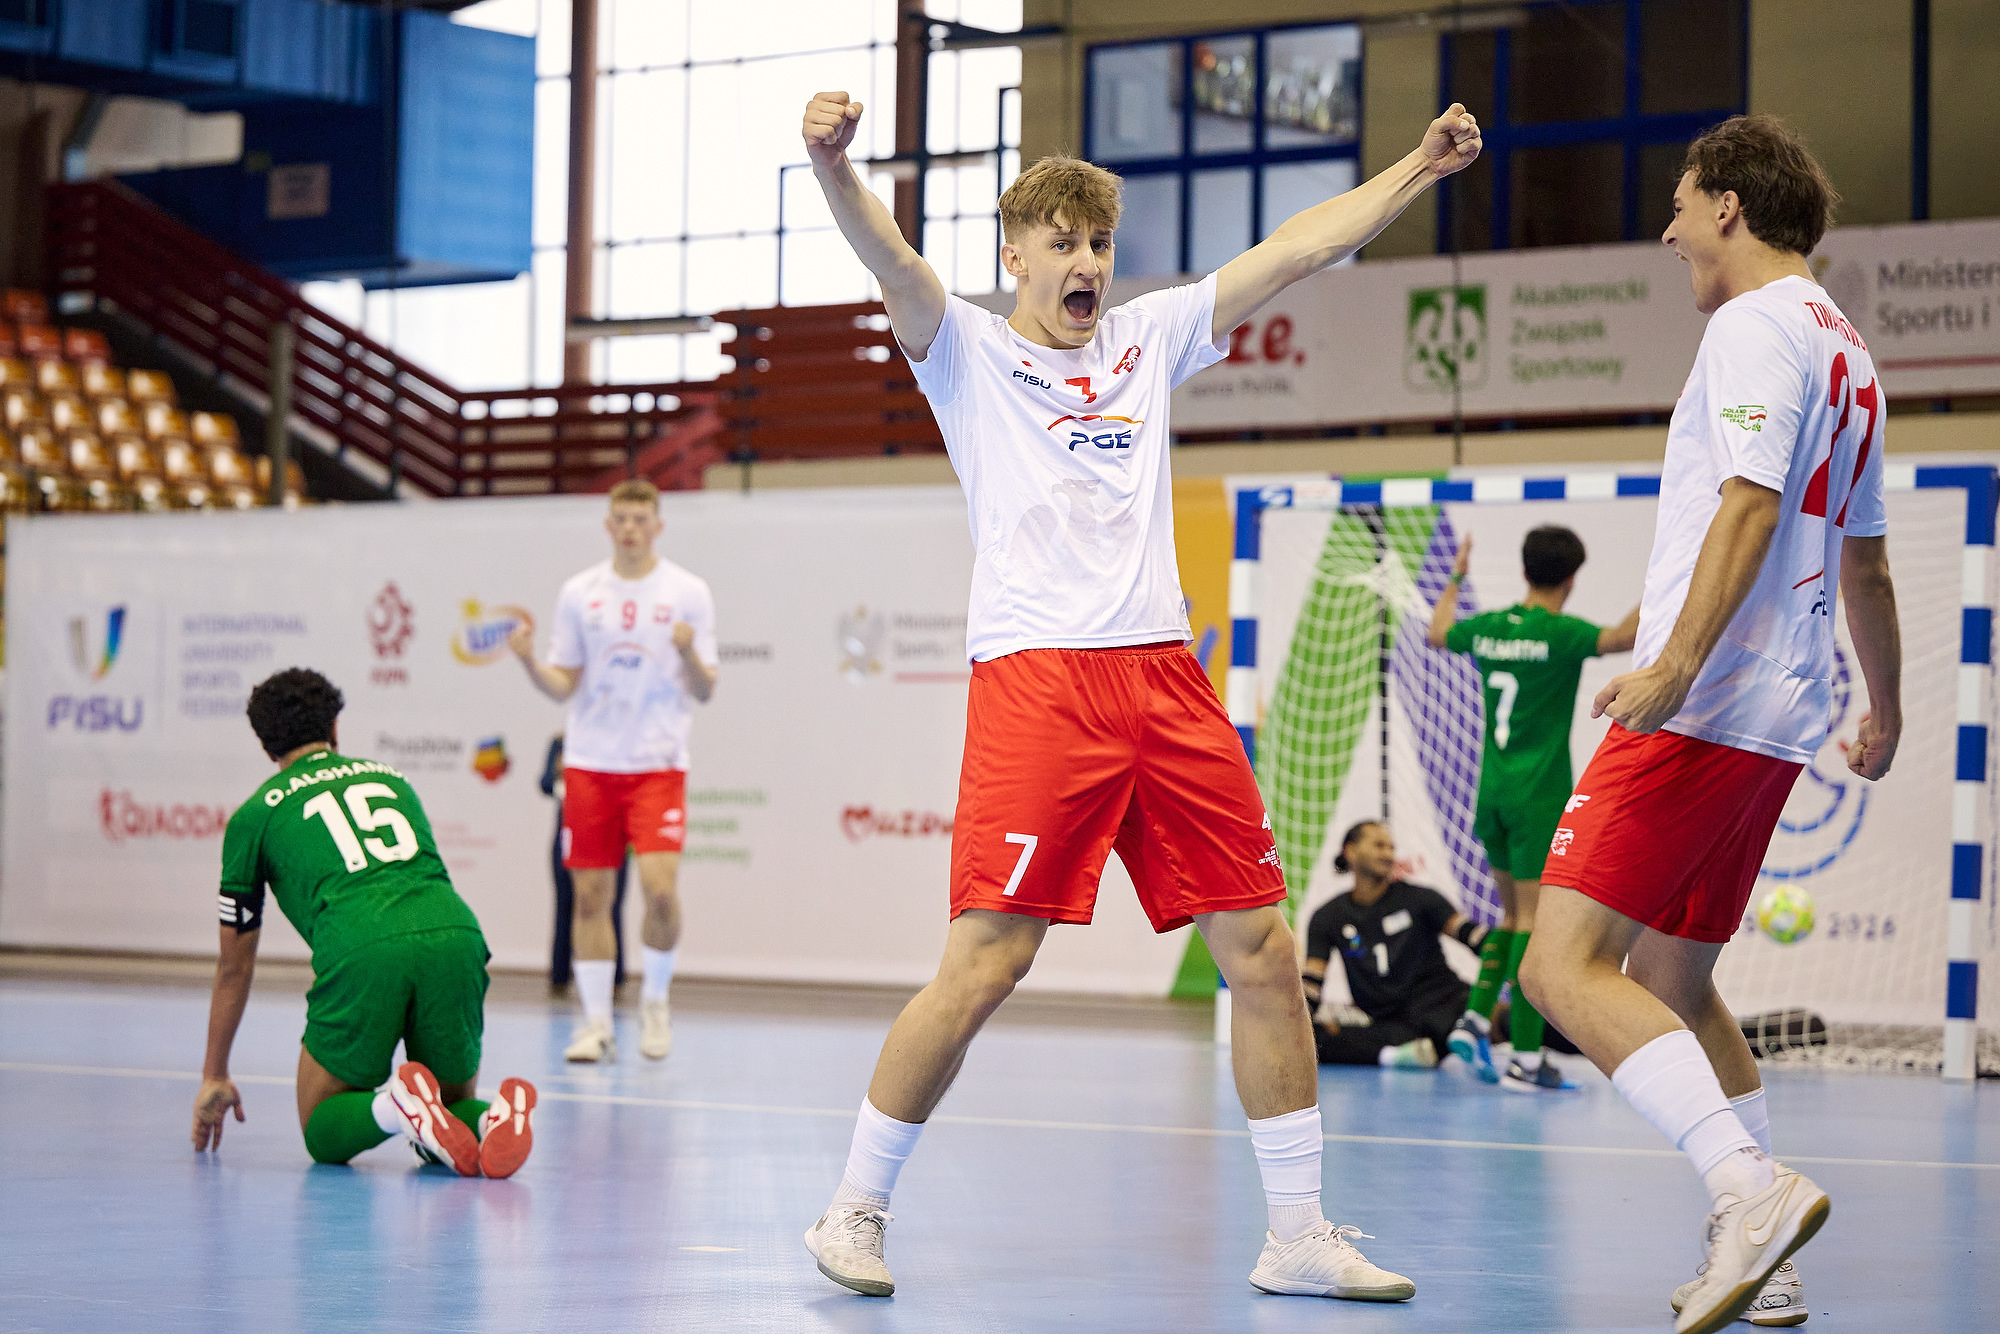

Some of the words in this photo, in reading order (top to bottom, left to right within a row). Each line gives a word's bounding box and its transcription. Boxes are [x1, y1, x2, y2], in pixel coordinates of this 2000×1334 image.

[1878, 260, 2000, 290] Minister
[1877, 301, 1974, 336] Sportu
[1013, 370, 1051, 390] FISU
[1069, 430, 1132, 451] PGE
[622, 600, 636, 631] 9
[48, 697, 144, 732] FISU
[1488, 671, 1519, 750] 7
[303, 782, 419, 873] 15
[1002, 832, 1038, 896] 7
[1829, 913, 1896, 939] 2026
[1373, 943, 1389, 976] 1
